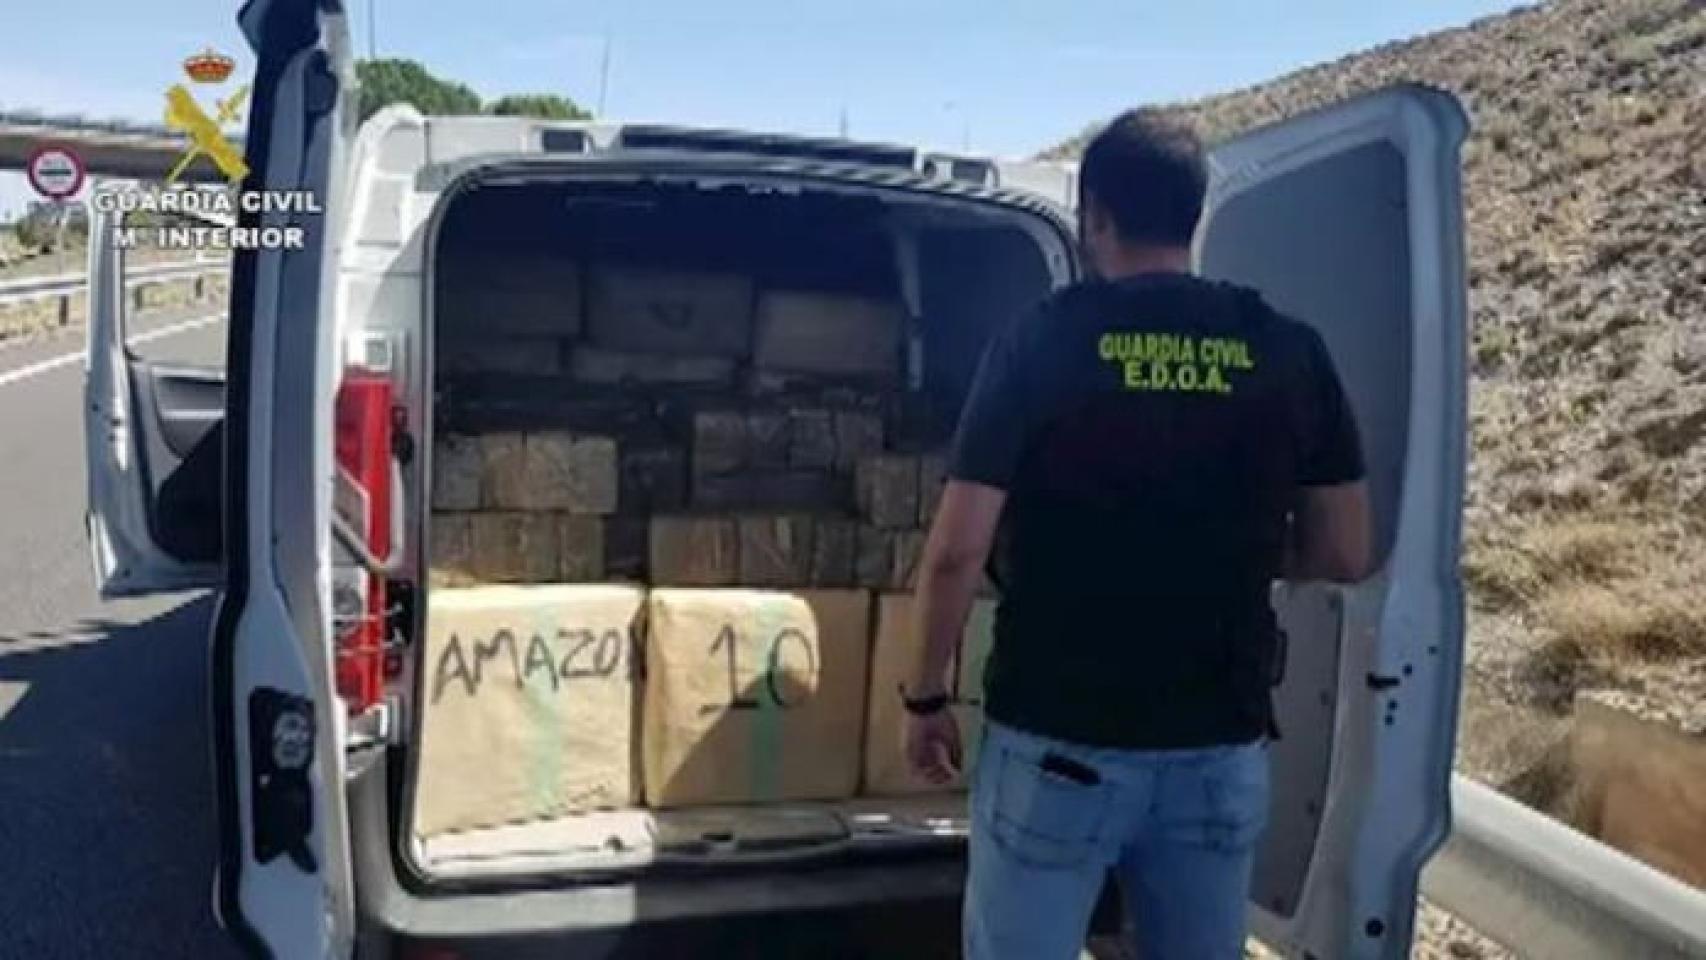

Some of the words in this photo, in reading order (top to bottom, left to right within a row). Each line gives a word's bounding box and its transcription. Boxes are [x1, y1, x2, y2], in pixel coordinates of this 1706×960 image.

[1099, 333, 1194, 361] GUARDIA
[1200, 338, 1254, 368] CIVIL
[1125, 361, 1232, 392] E.D.O.A.
[697, 625, 814, 713] 10
